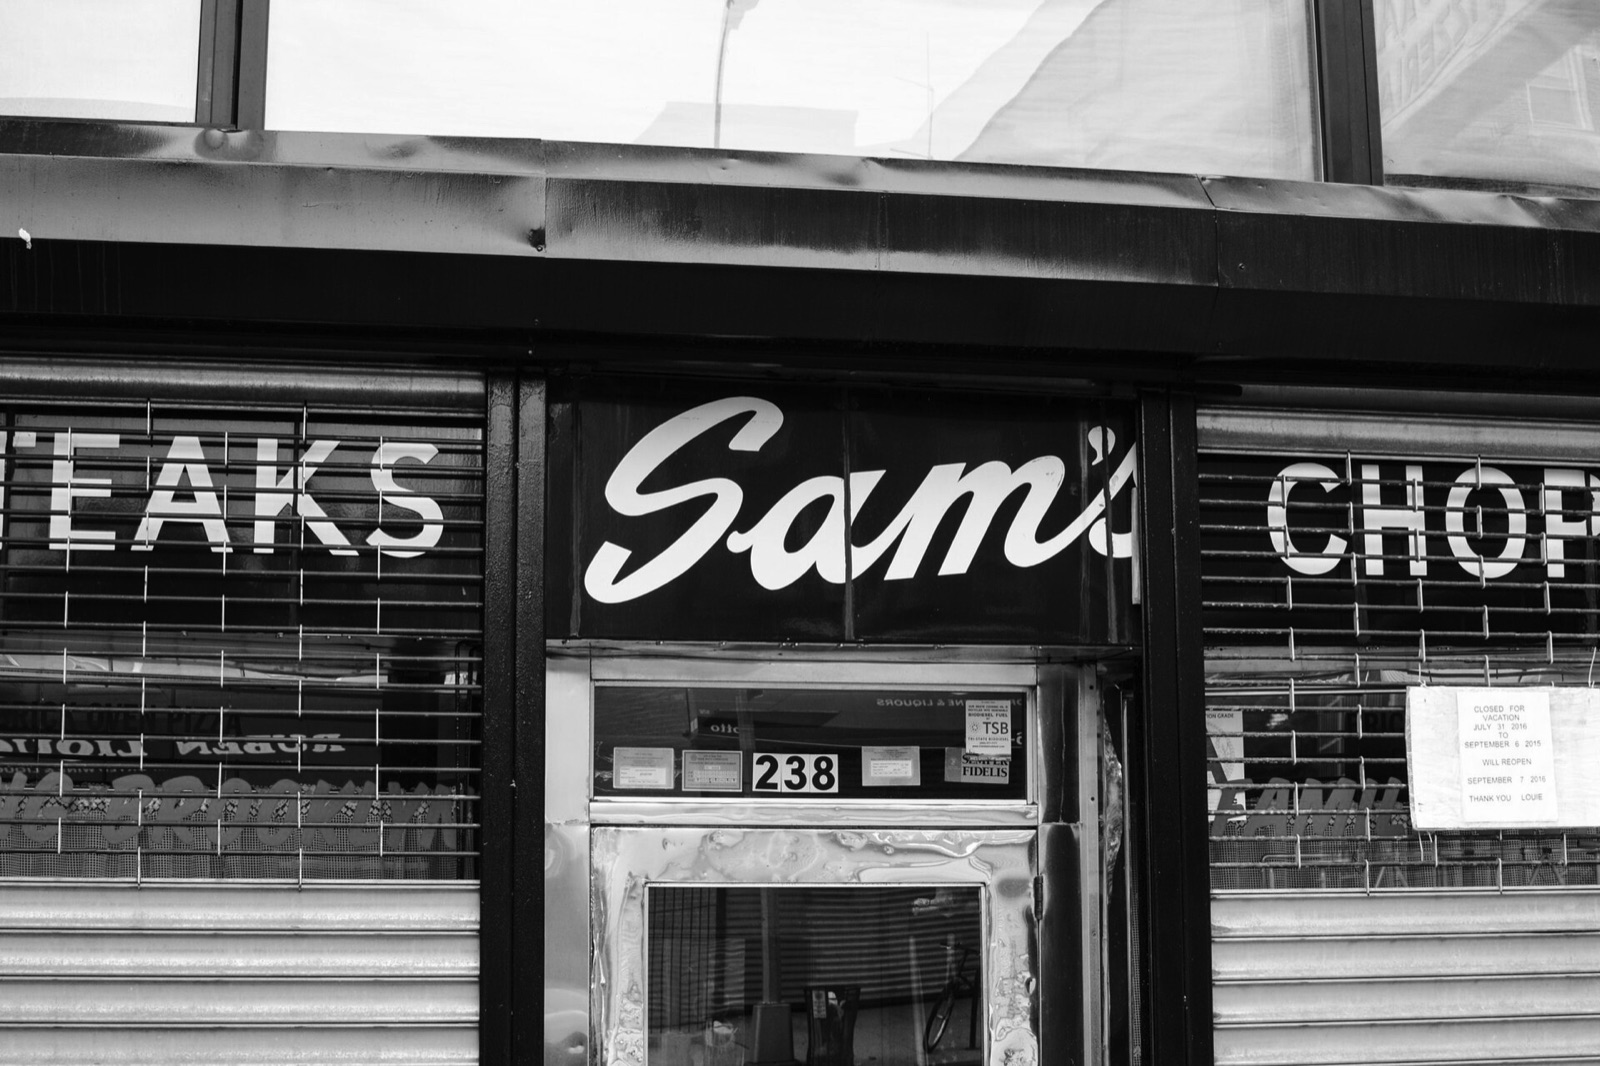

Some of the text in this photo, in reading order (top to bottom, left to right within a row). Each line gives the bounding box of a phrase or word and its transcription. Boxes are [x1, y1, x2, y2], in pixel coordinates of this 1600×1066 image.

[1474, 705, 1504, 713] CLOSED
[167, 705, 243, 735] PIZZA
[1482, 714, 1520, 722] VACATION
[982, 722, 1009, 734] TSB
[1474, 724, 1491, 732] JULY
[1464, 741, 1510, 749] SEPTEMBER
[1482, 758, 1500, 766] WILL
[754, 754, 836, 791] 238
[962, 766, 1008, 778] FIDELIS
[1468, 777, 1512, 785] SEPTEMBER
[1469, 794, 1543, 803] THANK YOU LOUIE
[102, 774, 475, 849] BROOKLYN
